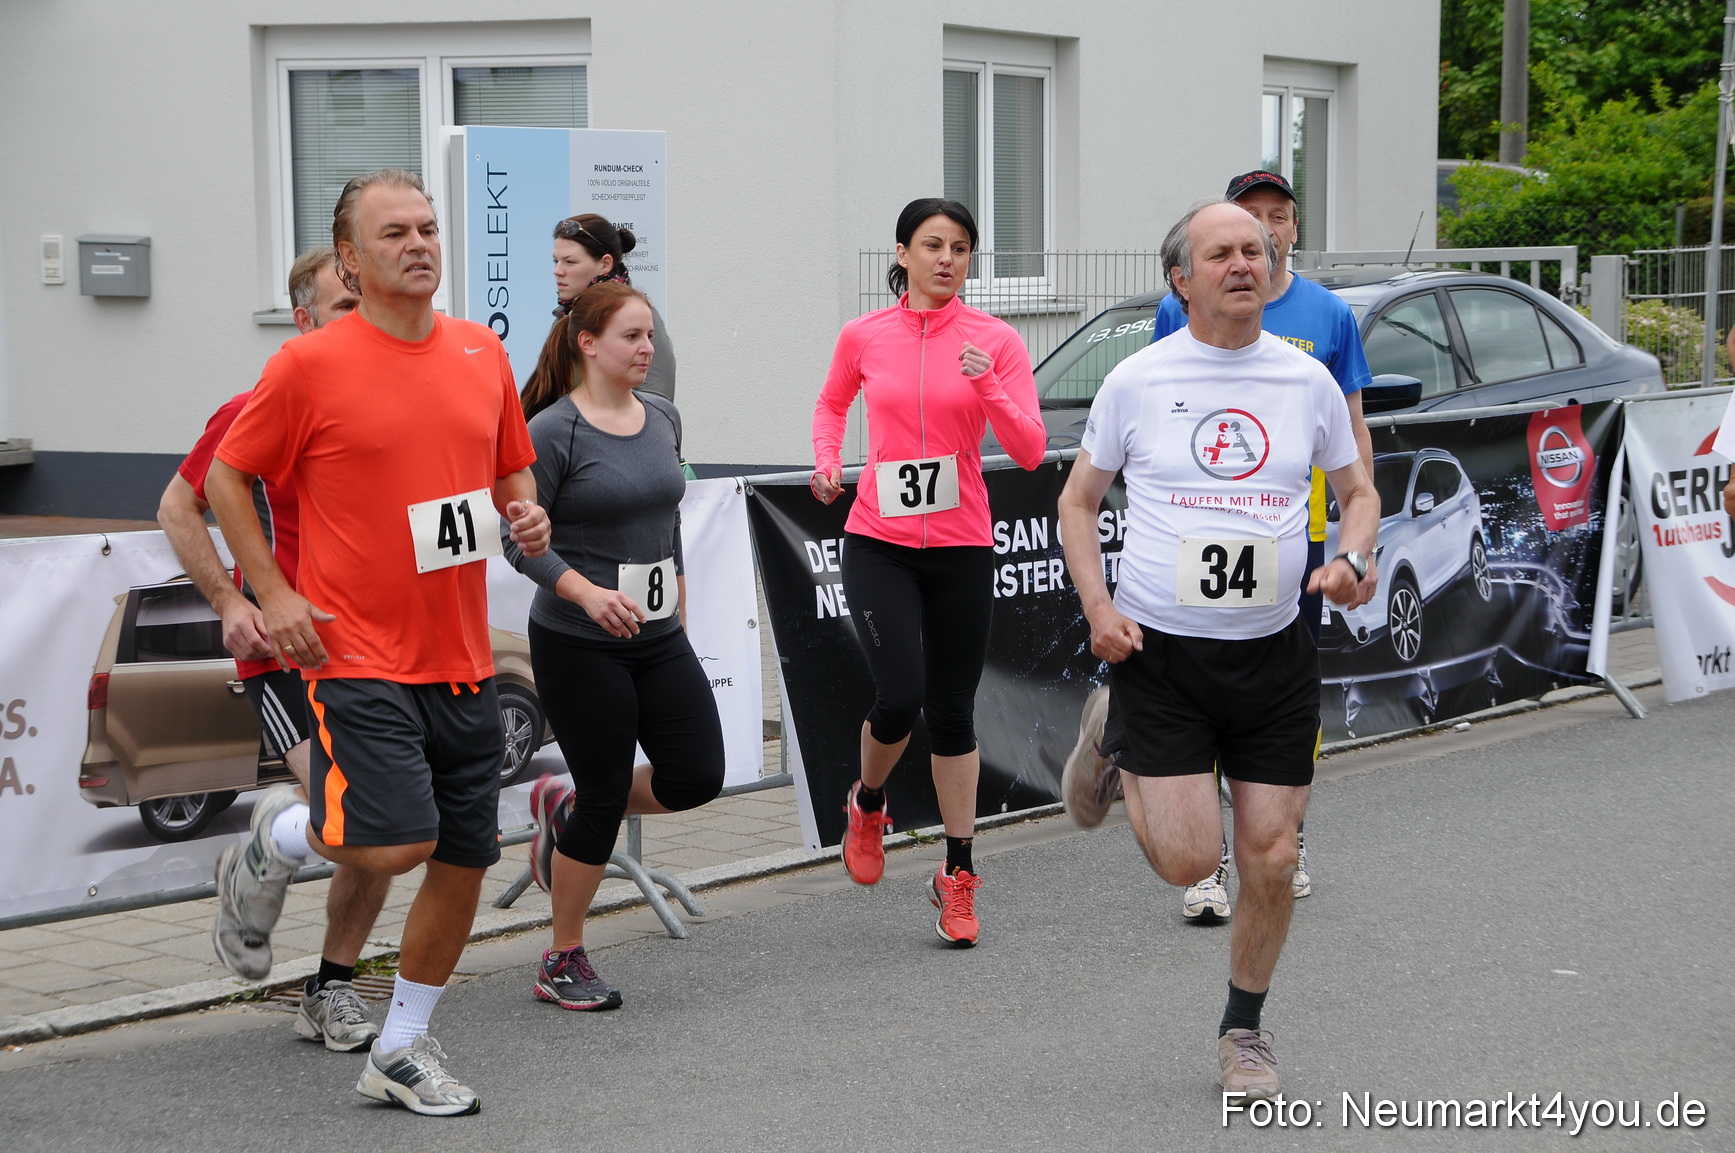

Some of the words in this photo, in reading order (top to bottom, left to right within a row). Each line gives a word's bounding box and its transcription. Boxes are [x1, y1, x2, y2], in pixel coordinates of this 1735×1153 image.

[587, 179, 600, 187] 100%
[601, 179, 616, 187] VOLVO
[617, 179, 651, 187] ORIGINALTEILE
[594, 164, 644, 173] RUNDUM-CHECK
[591, 193, 646, 201] SCHECKHEFTGEPFLEGT
[487, 162, 509, 358] OSELEKT
[1541, 450, 1579, 465] NISSAN
[899, 461, 940, 508] 37
[1171, 493, 1223, 507] LAUFEN
[1230, 496, 1254, 507] MIT
[1260, 493, 1291, 508] HERZ
[437, 499, 477, 556] 41
[1200, 544, 1257, 599] 34
[647, 566, 664, 612] 8
